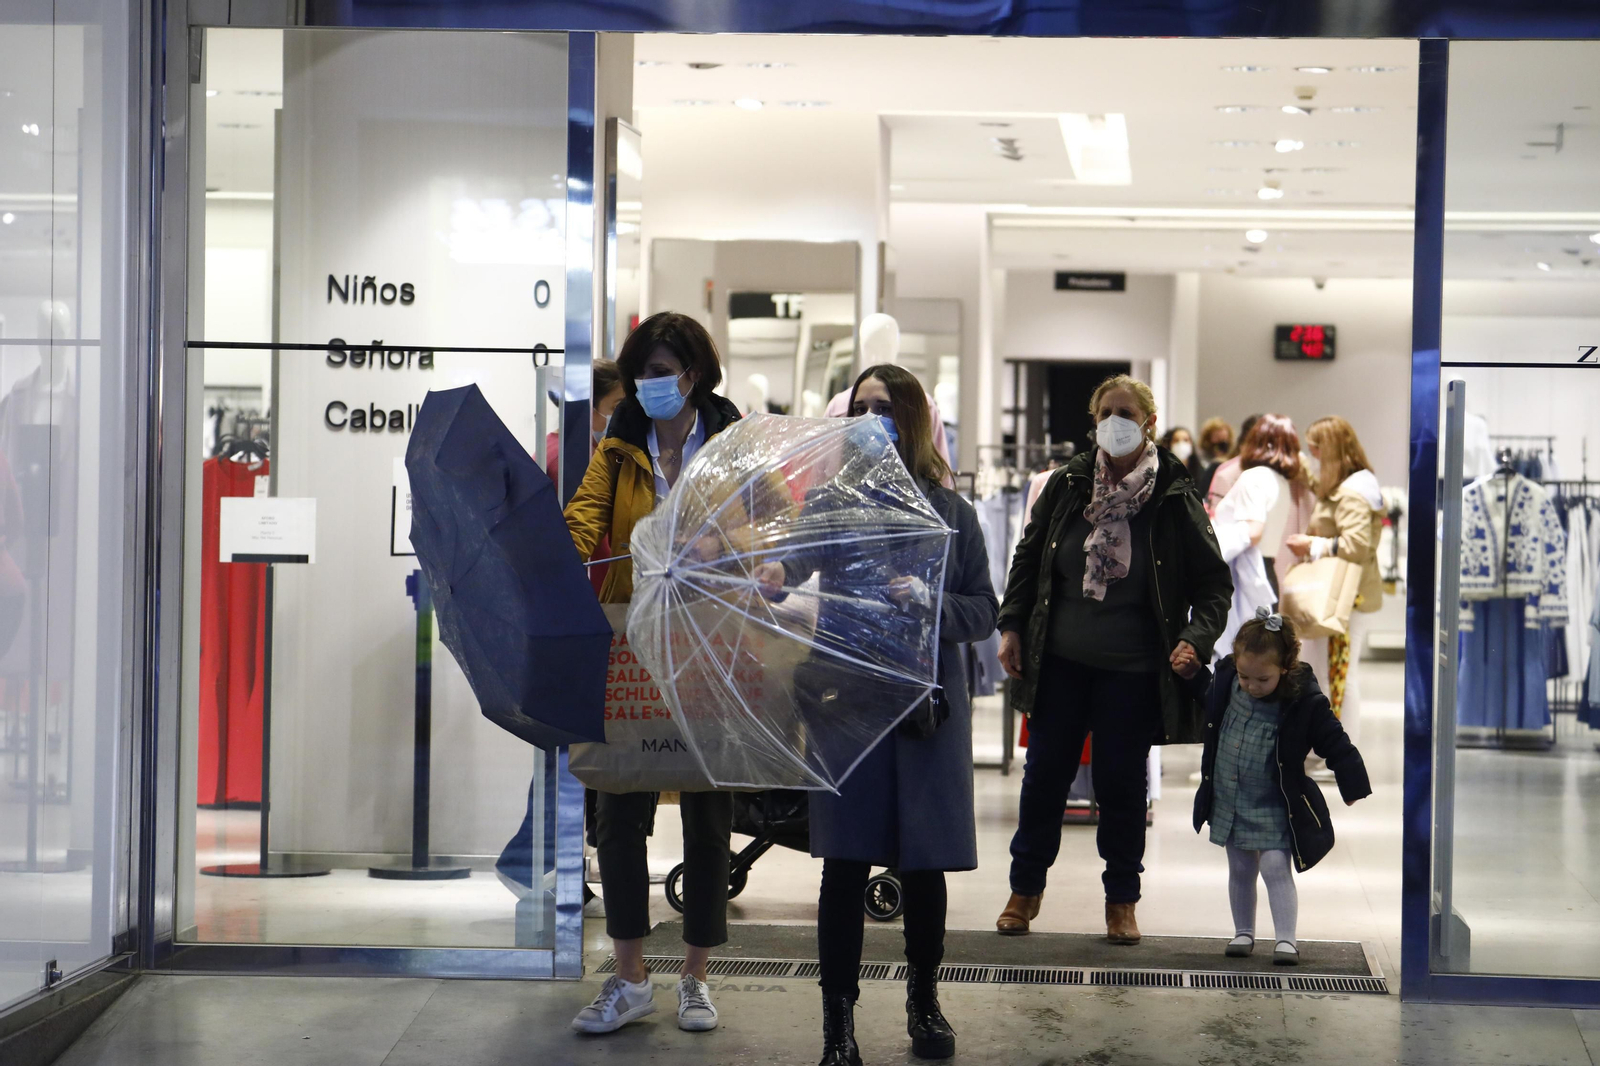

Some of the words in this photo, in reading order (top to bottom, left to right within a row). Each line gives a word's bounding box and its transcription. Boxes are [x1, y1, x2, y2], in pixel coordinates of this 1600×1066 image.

[327, 274, 415, 304] Niños
[326, 338, 434, 369] Señora
[1577, 346, 1598, 362] Z
[606, 668, 652, 684] SALD
[604, 687, 663, 702] SCHLU
